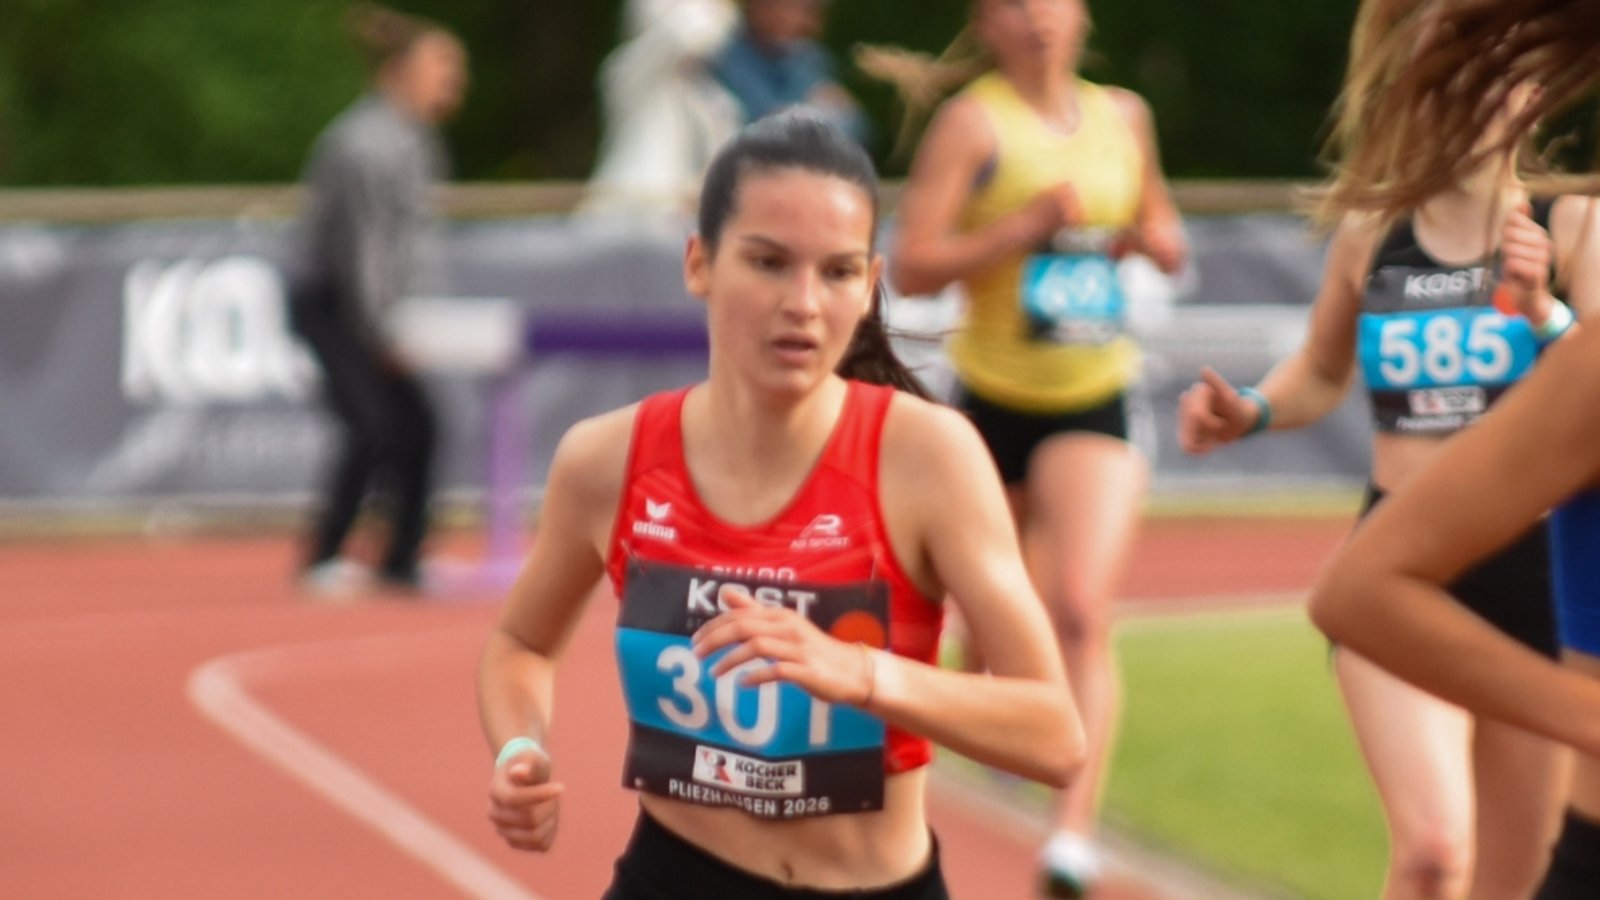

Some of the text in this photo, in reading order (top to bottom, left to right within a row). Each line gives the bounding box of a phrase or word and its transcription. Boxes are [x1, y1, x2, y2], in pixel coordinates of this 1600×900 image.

[1404, 267, 1487, 298] KOST
[1379, 314, 1513, 386] 585
[734, 759, 797, 777] KOCHER
[744, 775, 786, 791] BECK
[668, 778, 829, 816] PLIEZHAUSEN 2026
